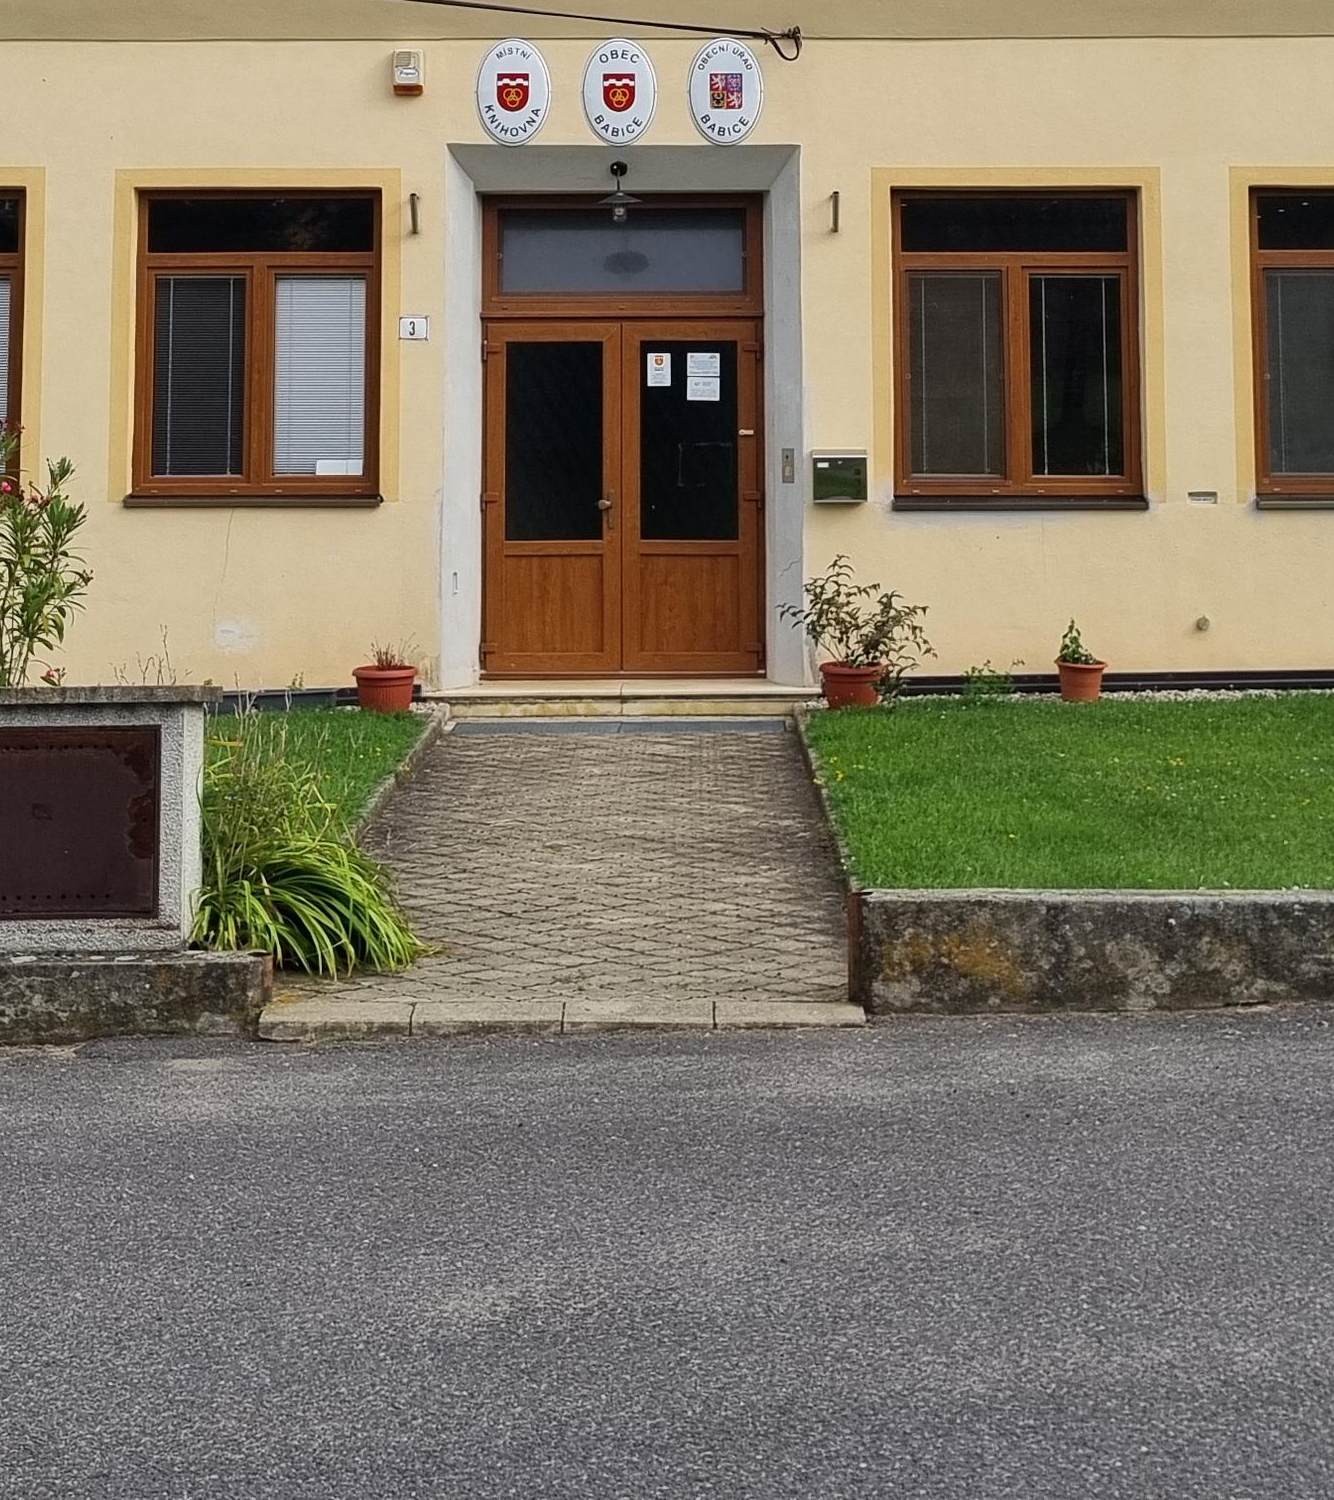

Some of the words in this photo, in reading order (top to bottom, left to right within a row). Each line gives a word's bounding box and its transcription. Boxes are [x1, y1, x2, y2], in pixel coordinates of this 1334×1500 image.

[495, 47, 532, 60] MÍSTNÍ
[599, 49, 640, 64] OBEC
[697, 44, 729, 71] OBECNÍ
[484, 104, 541, 137] KNIHOVNA
[594, 114, 643, 137] BABICE
[700, 114, 749, 137] BABICE
[409, 321, 415, 336] 3
